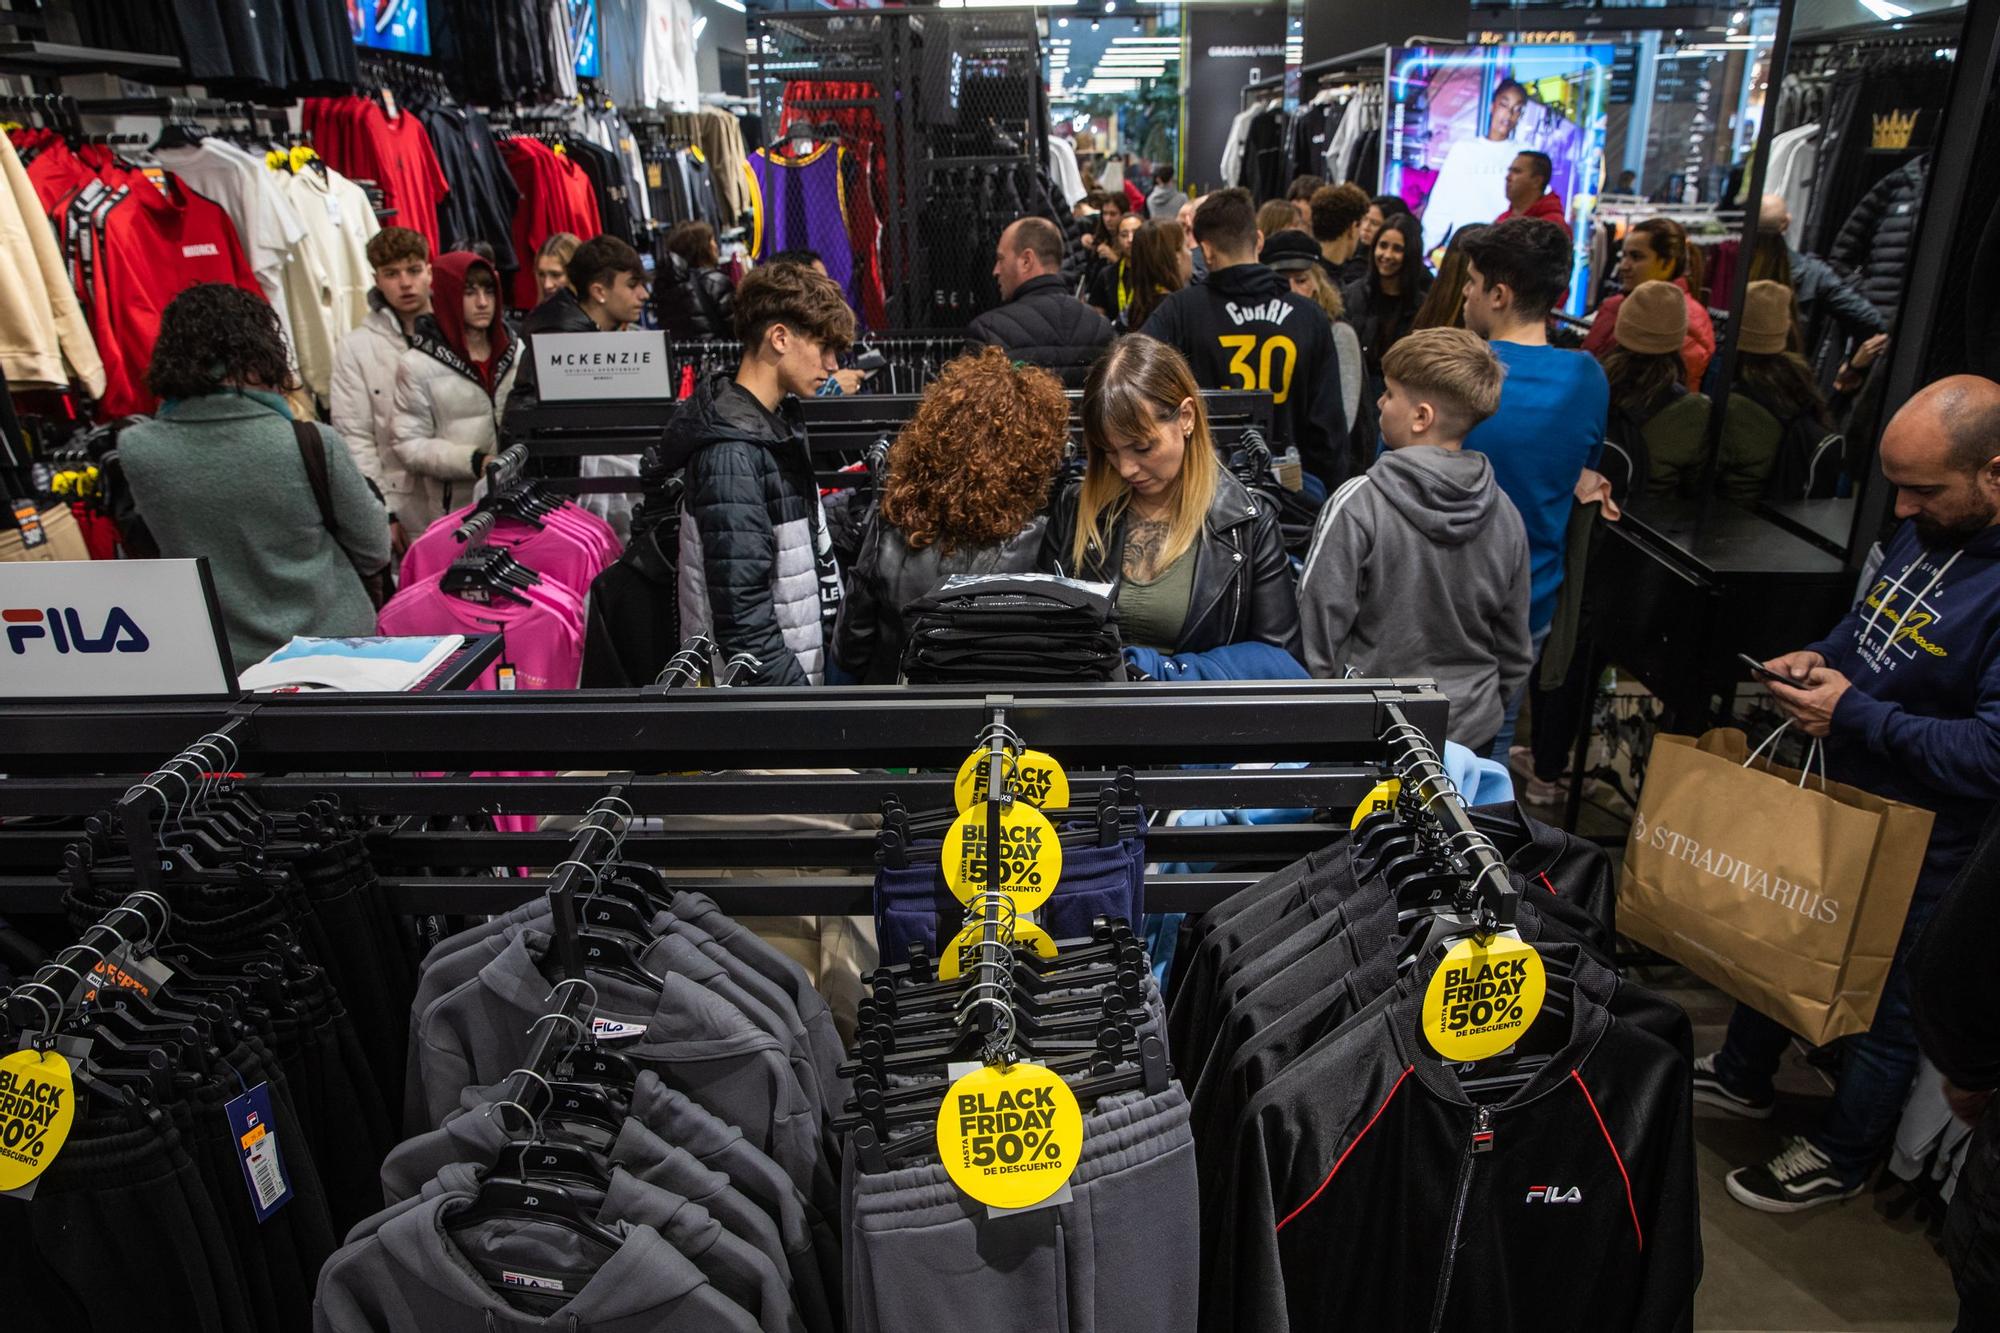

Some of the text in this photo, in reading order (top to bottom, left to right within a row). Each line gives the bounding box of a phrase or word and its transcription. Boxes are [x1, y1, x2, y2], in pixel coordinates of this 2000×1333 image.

[1225, 299, 1294, 325] CURRY
[551, 352, 651, 366] MCKENZIE
[1218, 335, 1297, 404] 30
[2, 606, 150, 654] FILA
[976, 762, 1054, 785] BACK
[962, 842, 1042, 860] FRDAY
[161, 860, 173, 871] JD
[1651, 826, 1840, 924] STRADIVARIUS
[1427, 889, 1442, 900] JD
[597, 911, 610, 921] JD
[1486, 919, 1496, 928] M
[588, 947, 600, 957] JD
[1445, 957, 1529, 988] BLACK
[1442, 977, 1526, 1006] FRIDAY
[1447, 995, 1524, 1031] 50%
[594, 1022, 624, 1033] FILA
[1455, 1020, 1521, 1038] DE DESCUENTO
[1007, 1051, 1016, 1061] M
[594, 1062, 606, 1071] JD
[0, 1069, 65, 1109] BLACK
[566, 1100, 579, 1109] JD
[958, 1086, 1056, 1115] BLACK
[960, 1108, 1056, 1137] FRIDAY
[962, 1130, 1061, 1168] HASTA 50%
[542, 1155, 558, 1165] JD
[984, 1161, 1062, 1176] DE DESCUENTO
[524, 1197, 539, 1206] JD
[1526, 1185, 1582, 1203] FILA
